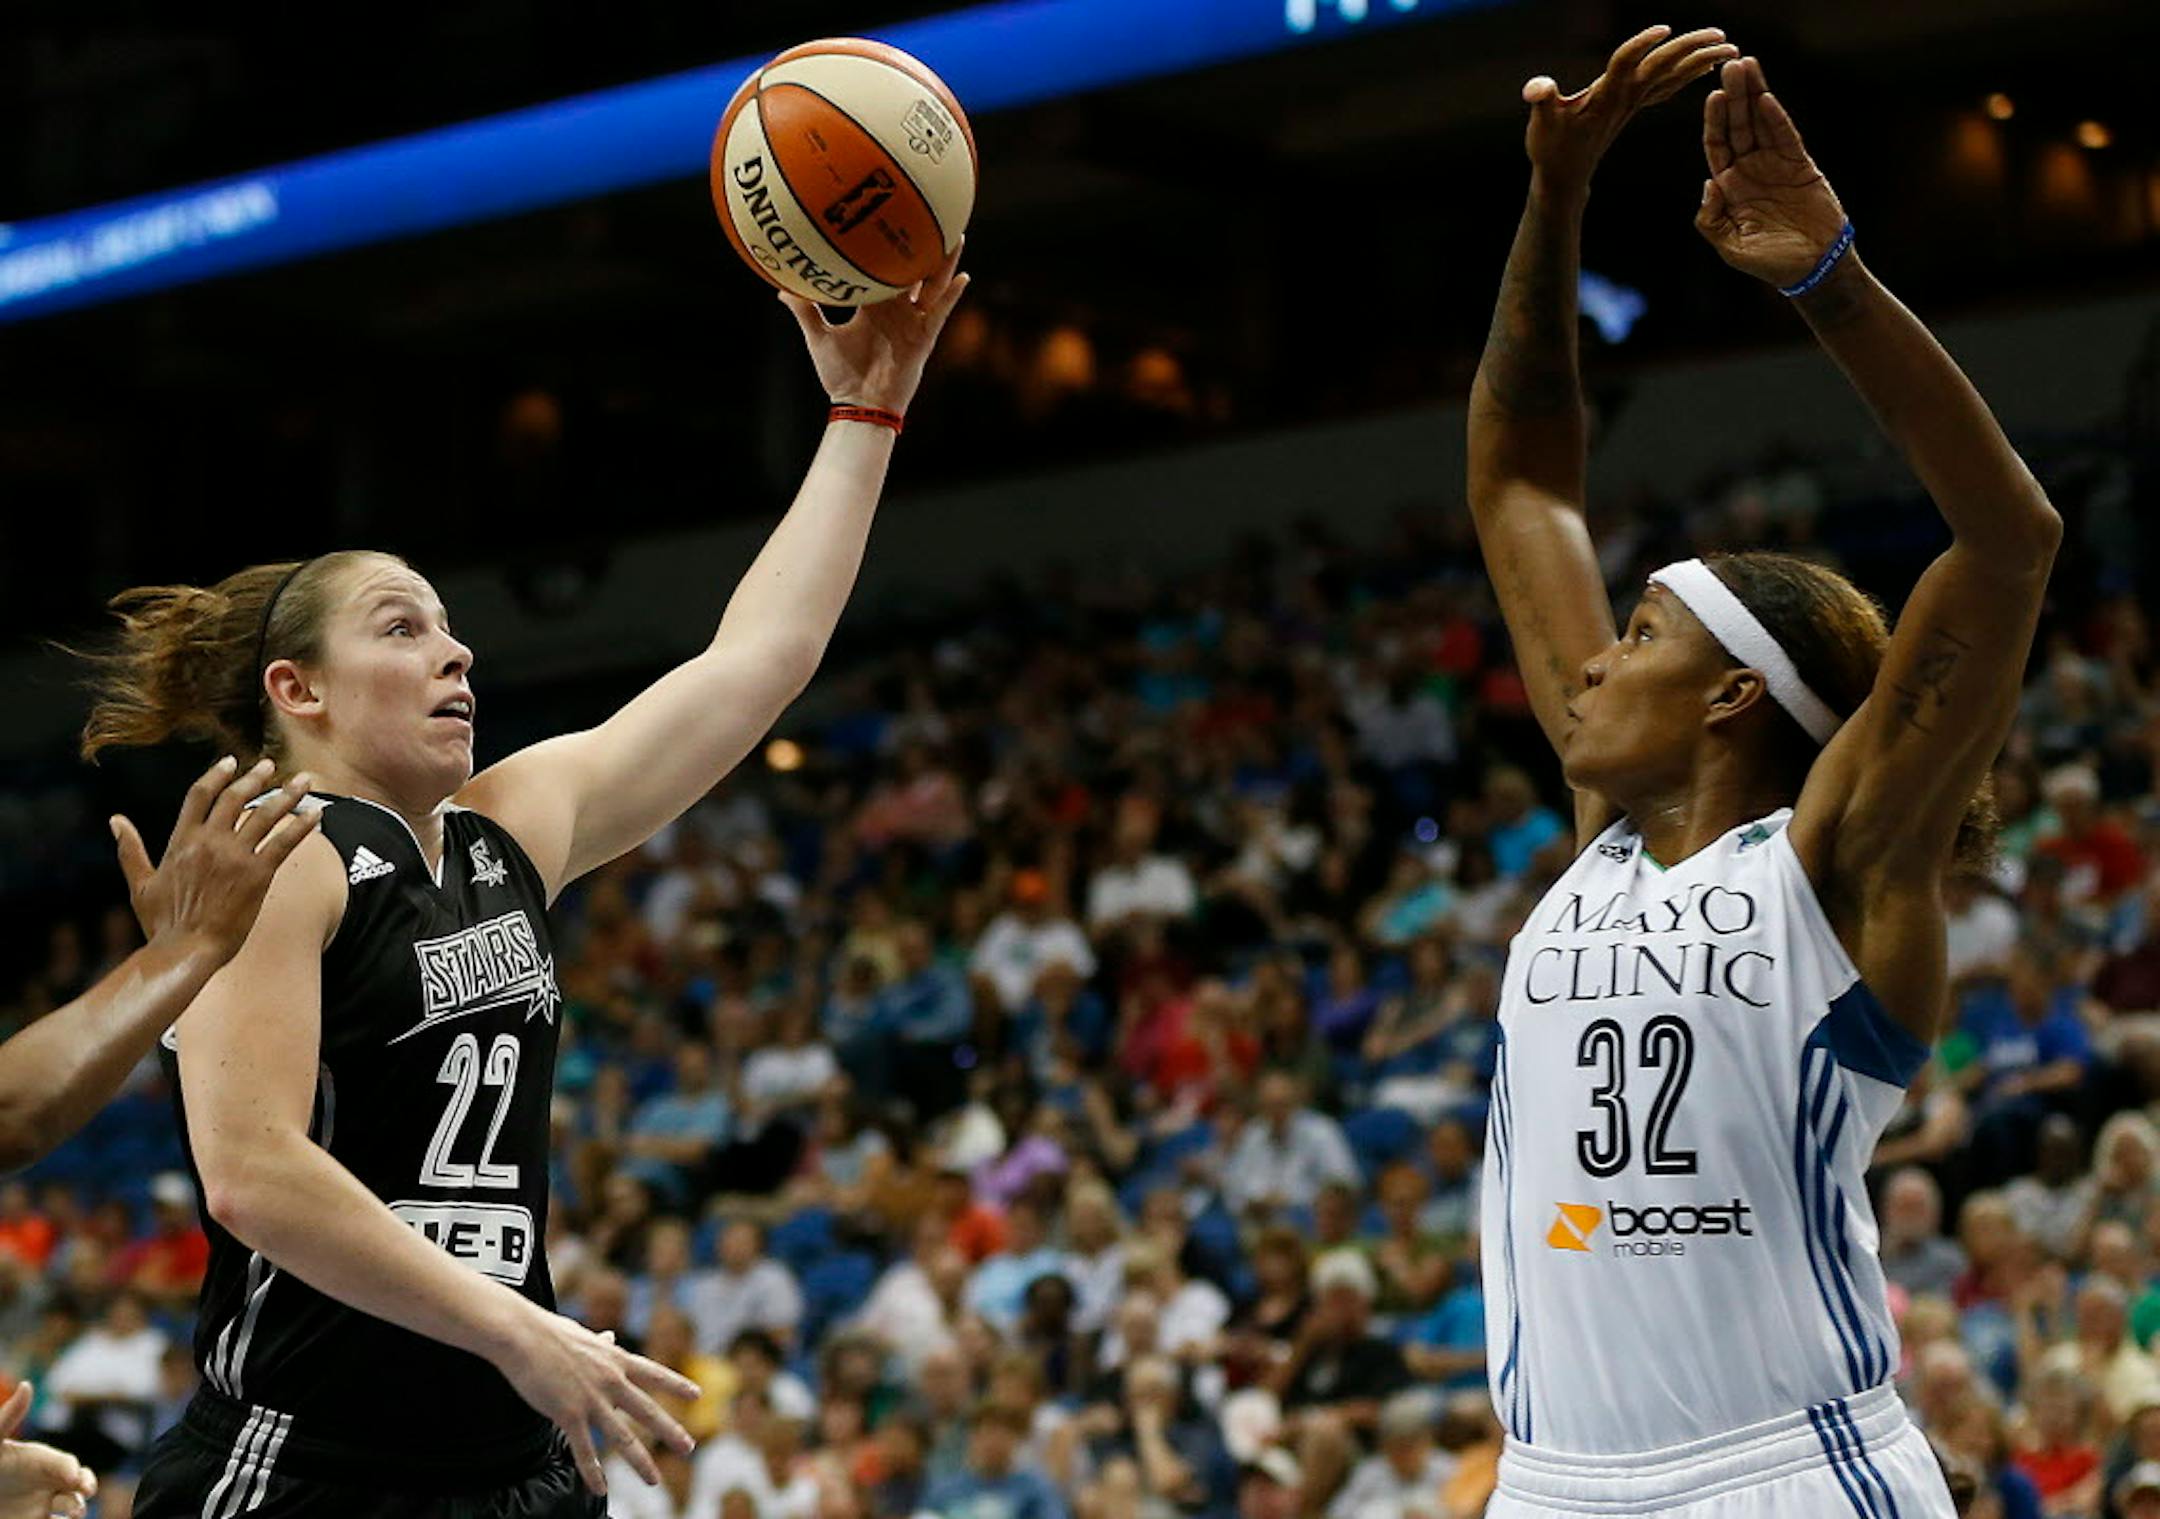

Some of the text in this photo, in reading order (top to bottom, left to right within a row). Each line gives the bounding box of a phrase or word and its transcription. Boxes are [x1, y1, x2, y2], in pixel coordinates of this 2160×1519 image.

[734, 156, 869, 300] SPALDING
[1547, 884, 1757, 935] MAYO
[415, 910, 541, 1017] STARS
[1526, 942, 1774, 1007] CLINIC
[419, 1033, 521, 1188] 22
[1576, 1014, 1697, 1178] 32
[1608, 1198, 1752, 1236] boost
[1614, 1238, 1685, 1257] mobile
